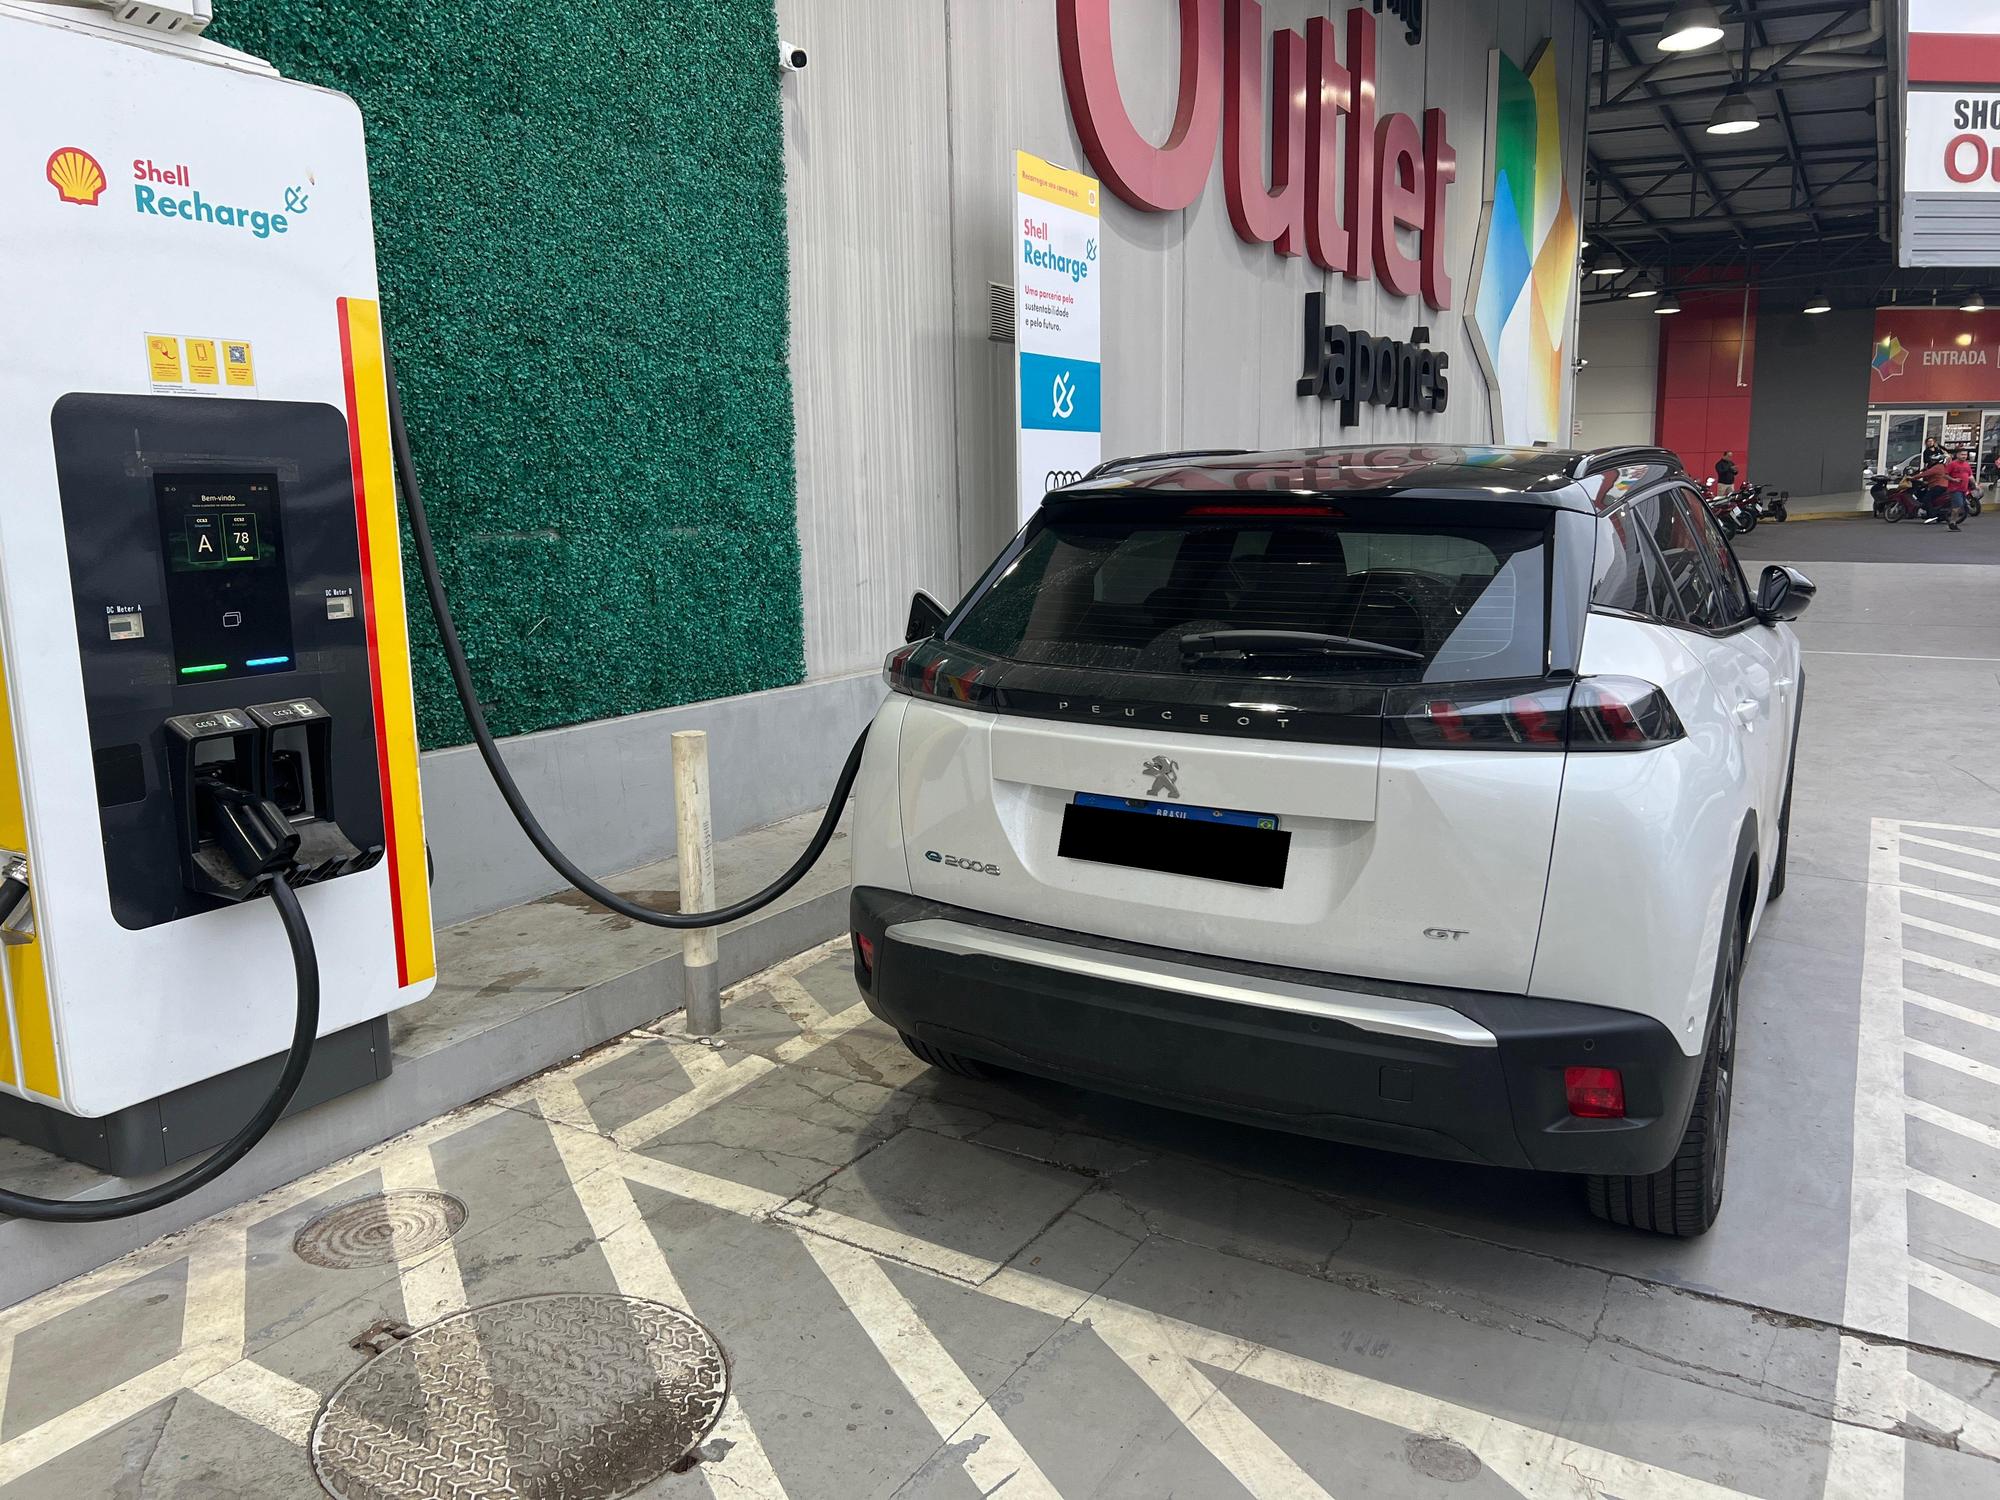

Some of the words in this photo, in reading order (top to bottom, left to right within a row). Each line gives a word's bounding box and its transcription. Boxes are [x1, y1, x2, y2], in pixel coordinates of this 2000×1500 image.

[1943, 133, 2000, 183] O
[133, 159, 190, 187] Shell
[135, 184, 288, 238] Recharge
[1024, 218, 1047, 240] Shell
[1024, 239, 1087, 283] Recharge
[1025, 285, 1038, 296] Uma
[1039, 290, 1061, 302] parceria
[1062, 293, 1074, 305] pela
[1025, 302, 1069, 318] sustentabilidade
[1030, 317, 1042, 329] pelo
[1043, 318, 1061, 331] futuro.
[1923, 350, 1986, 366] ENTRADA
[201, 494, 235, 502] Bem-vindo
[198, 534, 213, 553] A
[233, 531, 250, 544] 78
[325, 589, 332, 597] DC
[106, 605, 114, 614] DC
[116, 605, 134, 613] Meter
[137, 604, 142, 612] A
[273, 709, 294, 717] CCS2
[294, 703, 313, 716] B
[1058, 701, 1289, 728] PEUGEOT
[195, 719, 218, 728] CCS2
[222, 714, 242, 728] A
[1423, 927, 1470, 941] GT
